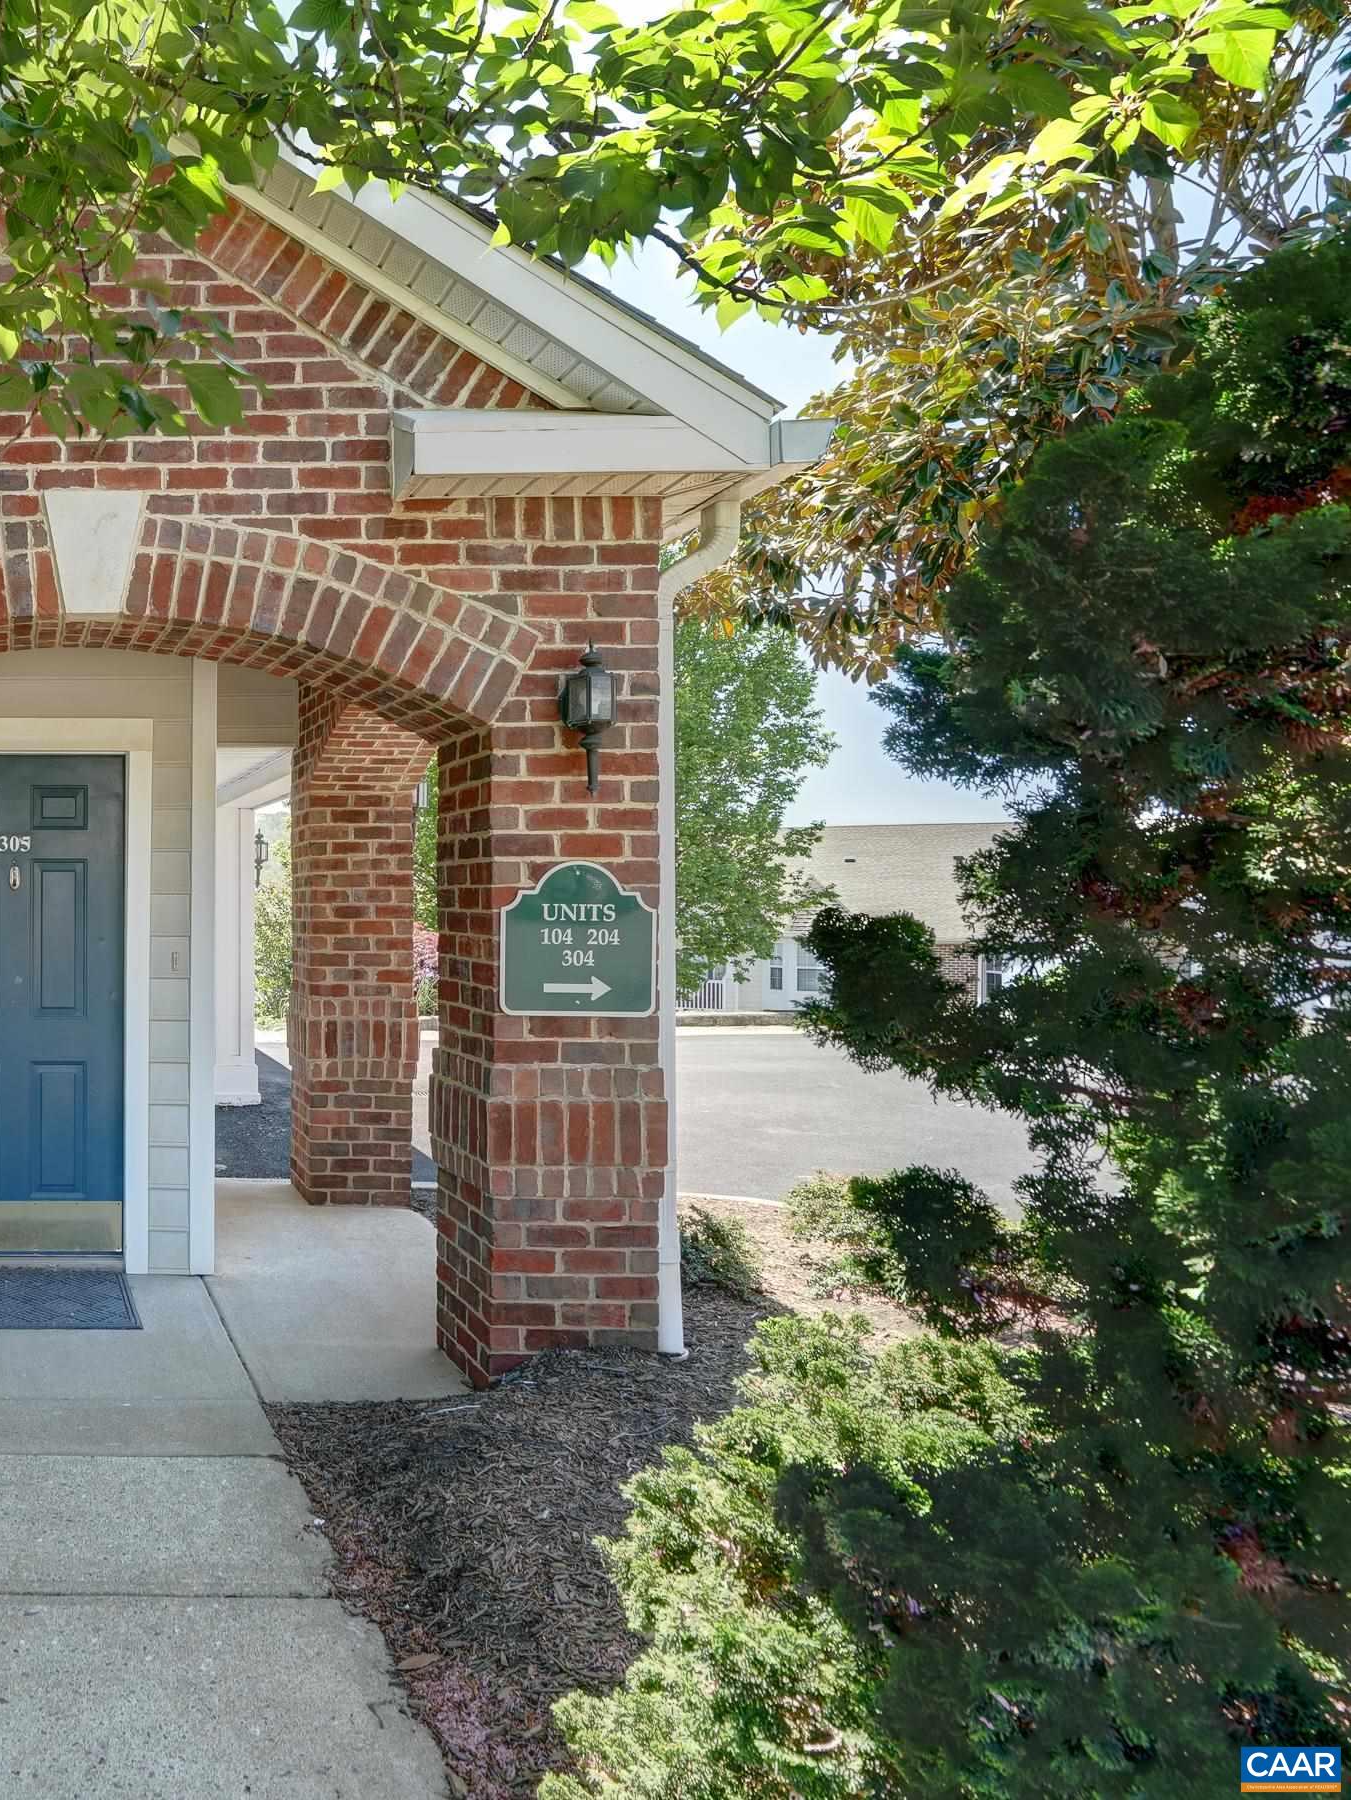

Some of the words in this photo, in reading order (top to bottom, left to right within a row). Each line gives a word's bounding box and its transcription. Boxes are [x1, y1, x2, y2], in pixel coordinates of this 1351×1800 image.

[541, 903, 616, 922] UNITS
[540, 927, 574, 945] 104
[586, 928, 620, 946] 204
[561, 949, 595, 967] 304
